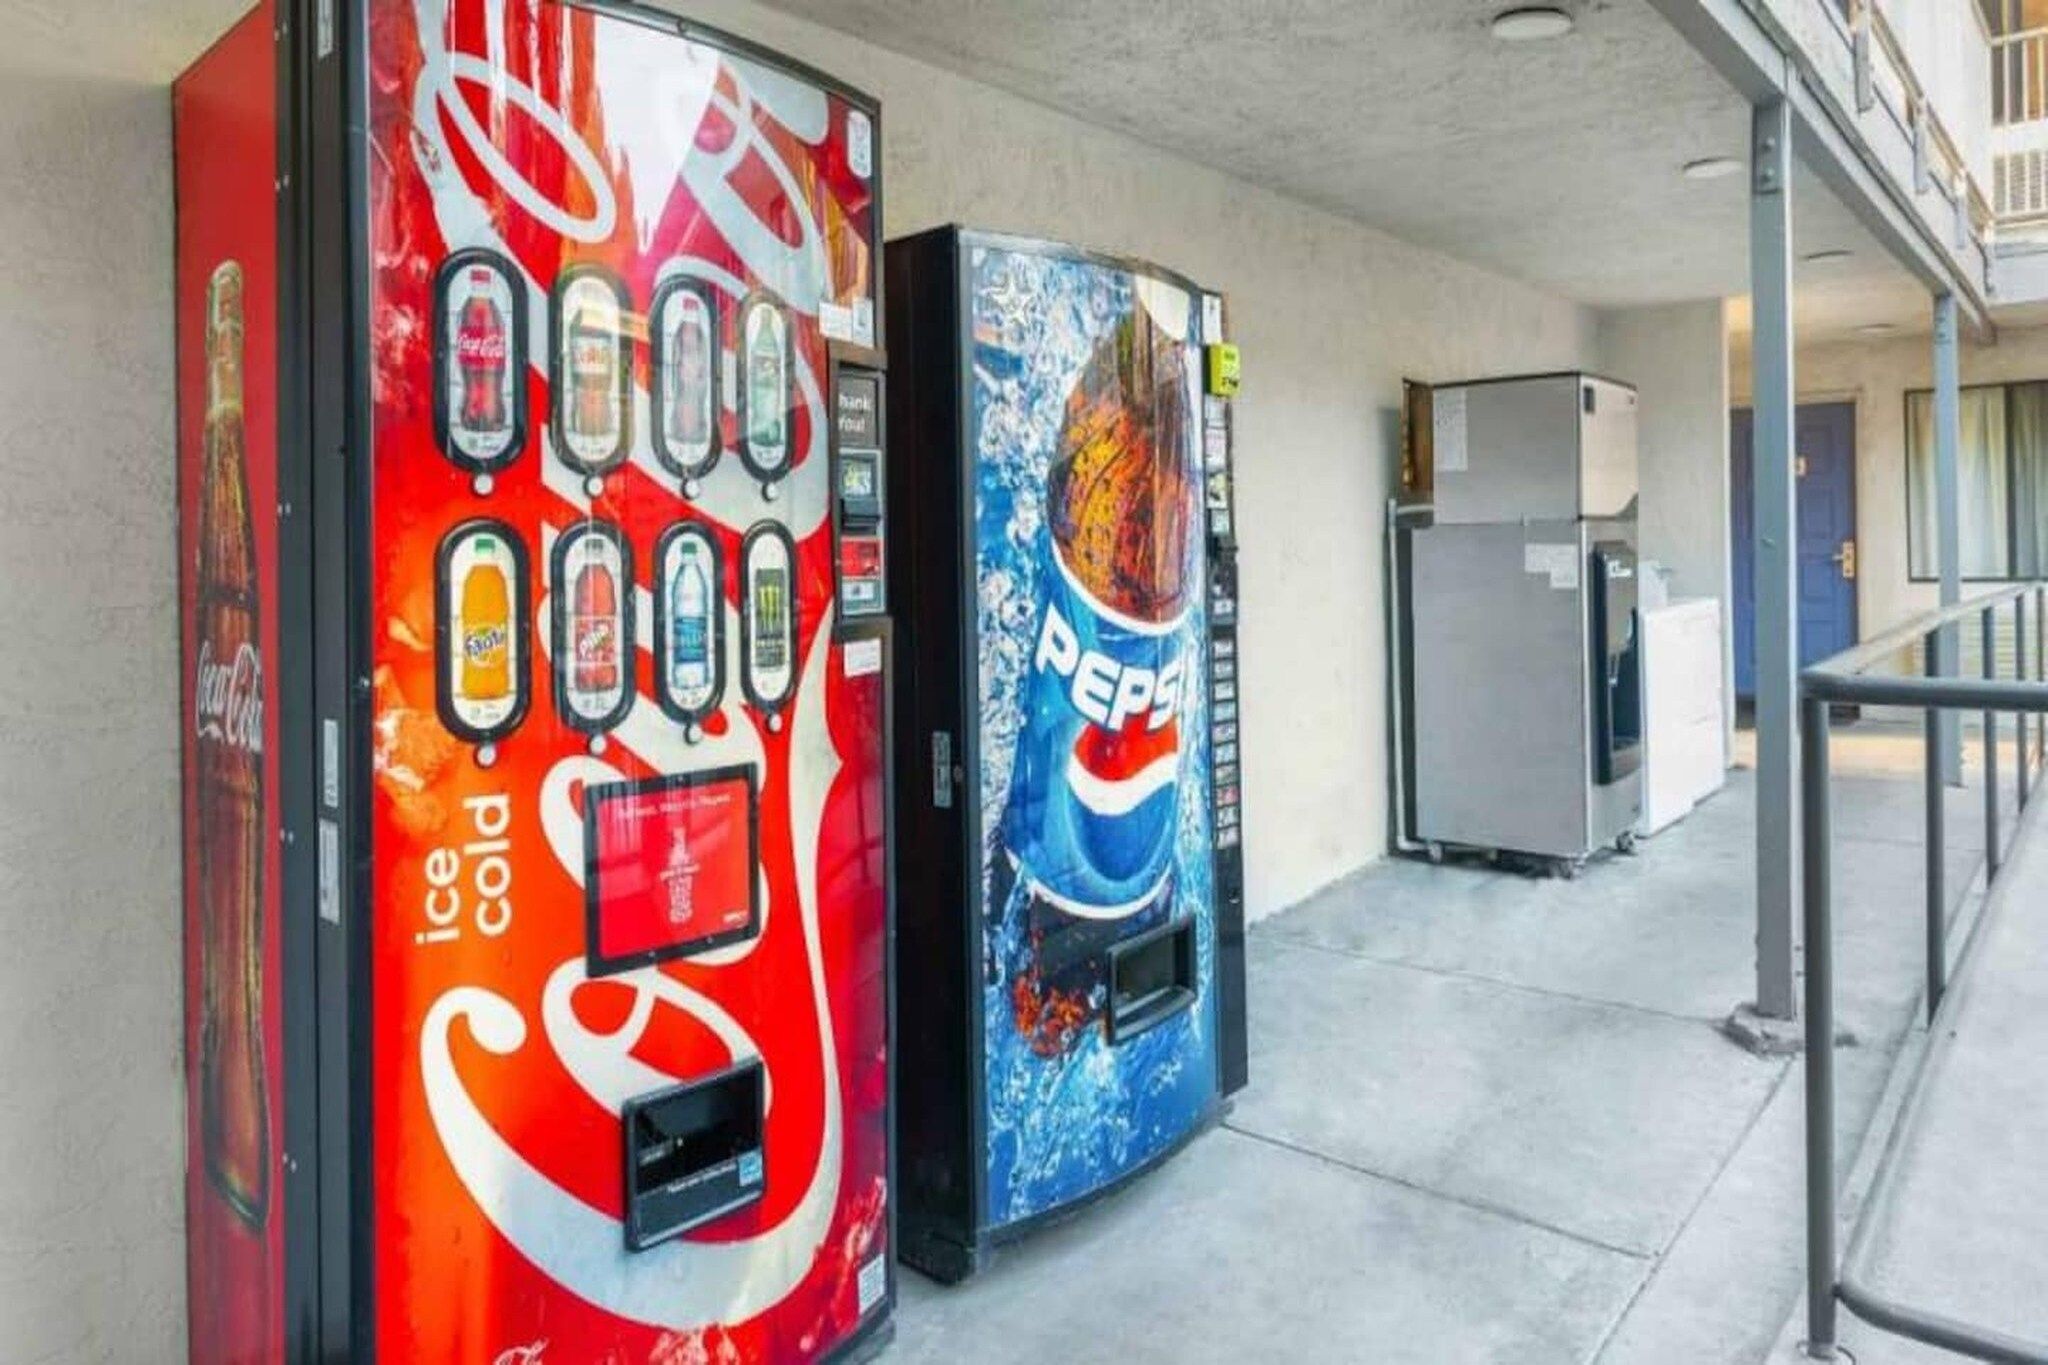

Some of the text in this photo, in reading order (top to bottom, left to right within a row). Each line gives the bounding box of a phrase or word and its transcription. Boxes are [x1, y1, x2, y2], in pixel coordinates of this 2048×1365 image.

[1034, 601, 1187, 732] PEPS
[415, 847, 460, 945] ice
[462, 793, 512, 937] cold
